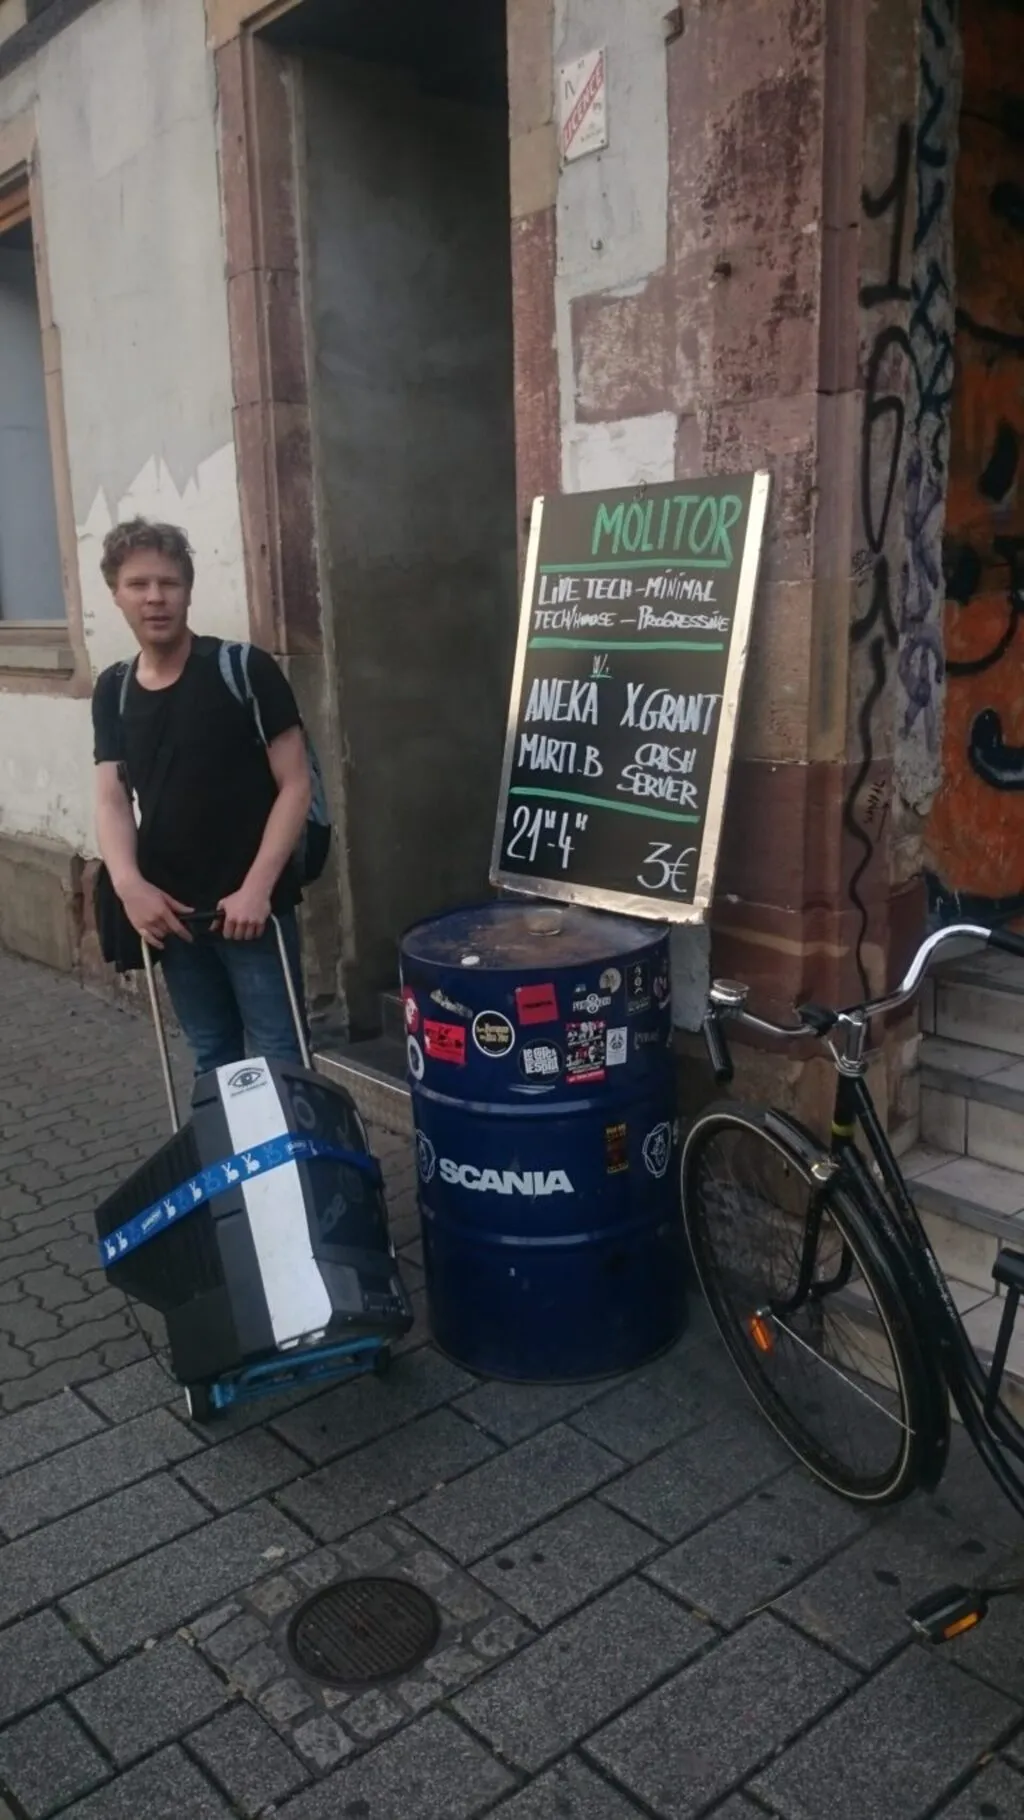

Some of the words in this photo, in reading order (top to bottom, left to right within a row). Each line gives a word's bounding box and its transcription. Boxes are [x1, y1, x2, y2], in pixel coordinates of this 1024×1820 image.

[591, 495, 742, 560] MOLITOR
[524, 678, 599, 726] ANEKA
[636, 743, 699, 774] CRASH
[618, 764, 701, 810] SERVER
[638, 842, 696, 894] 3€
[439, 1157, 575, 1196] SCANIA
